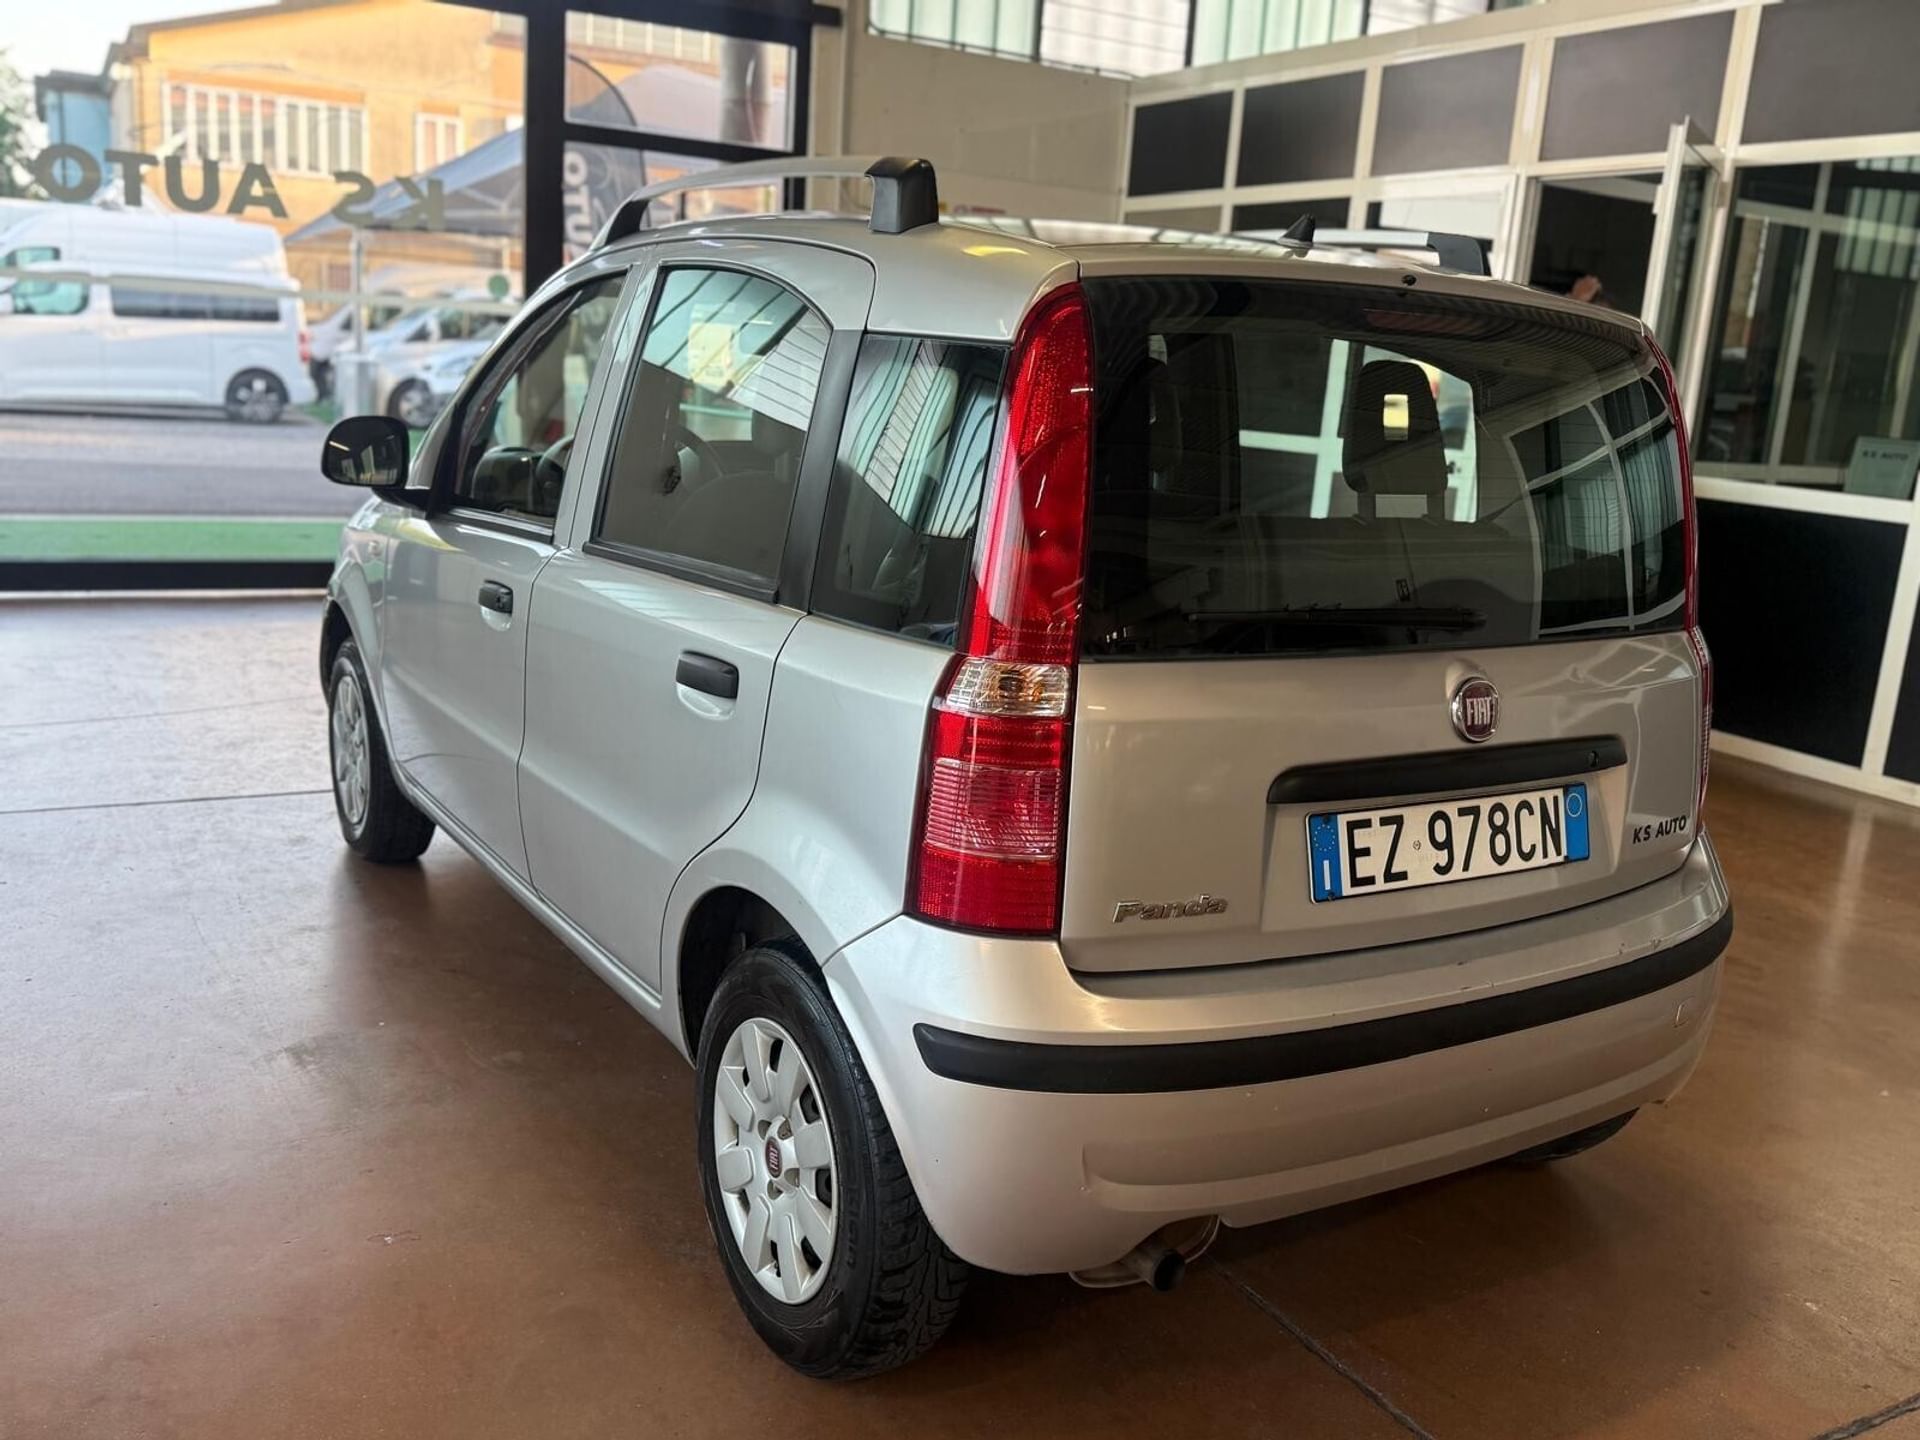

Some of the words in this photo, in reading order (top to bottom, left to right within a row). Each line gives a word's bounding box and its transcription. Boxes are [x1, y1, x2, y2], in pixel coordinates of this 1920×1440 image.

[1466, 697, 1492, 726] FIAT
[1345, 814, 1409, 888] EZ
[1427, 793, 1564, 877] 978CN
[1632, 824, 1652, 845] KS
[1655, 814, 1688, 839] AUTO
[1111, 895, 1229, 924] Panda
[769, 1147, 779, 1170] FIAT
